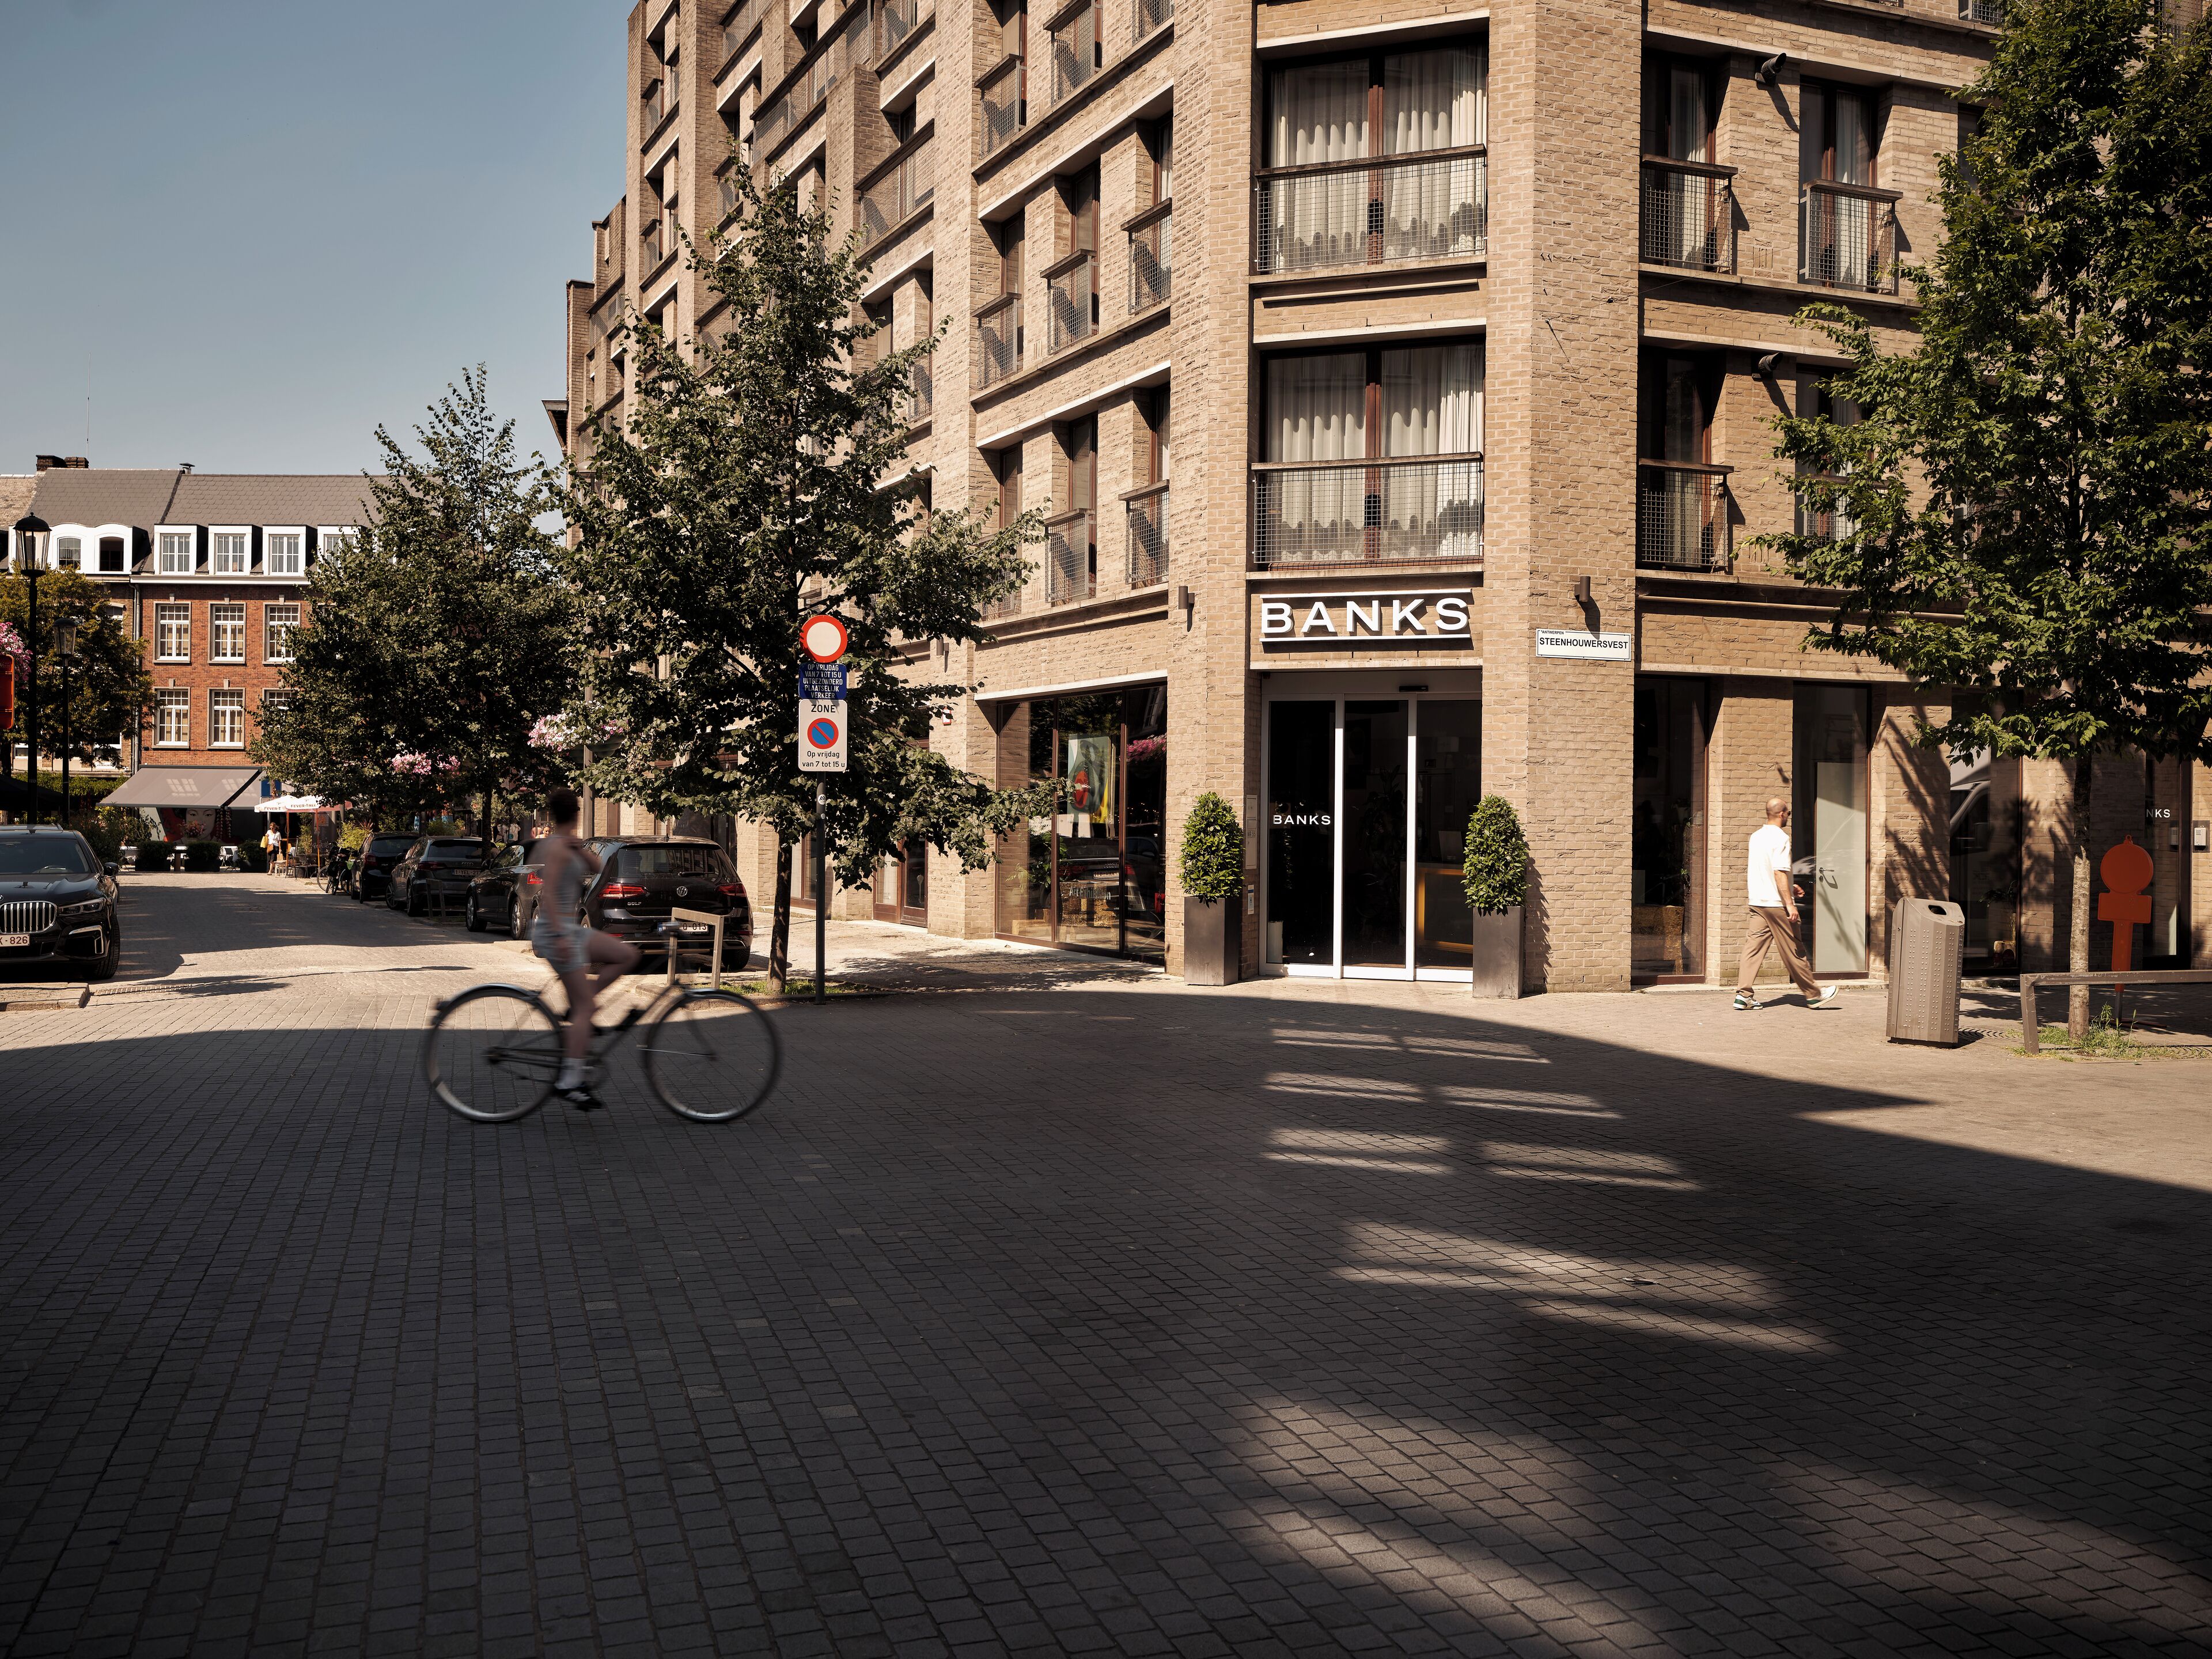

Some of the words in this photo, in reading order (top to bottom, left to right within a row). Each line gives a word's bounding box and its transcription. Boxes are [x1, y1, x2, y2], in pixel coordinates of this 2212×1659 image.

[1261, 597, 1469, 633] BANKS
[1539, 637, 1628, 649] STEENHOUWERSVEST
[811, 704, 836, 713] ZONE
[2146, 809, 2171, 818] NKS
[1273, 815, 1331, 825] BANKS
